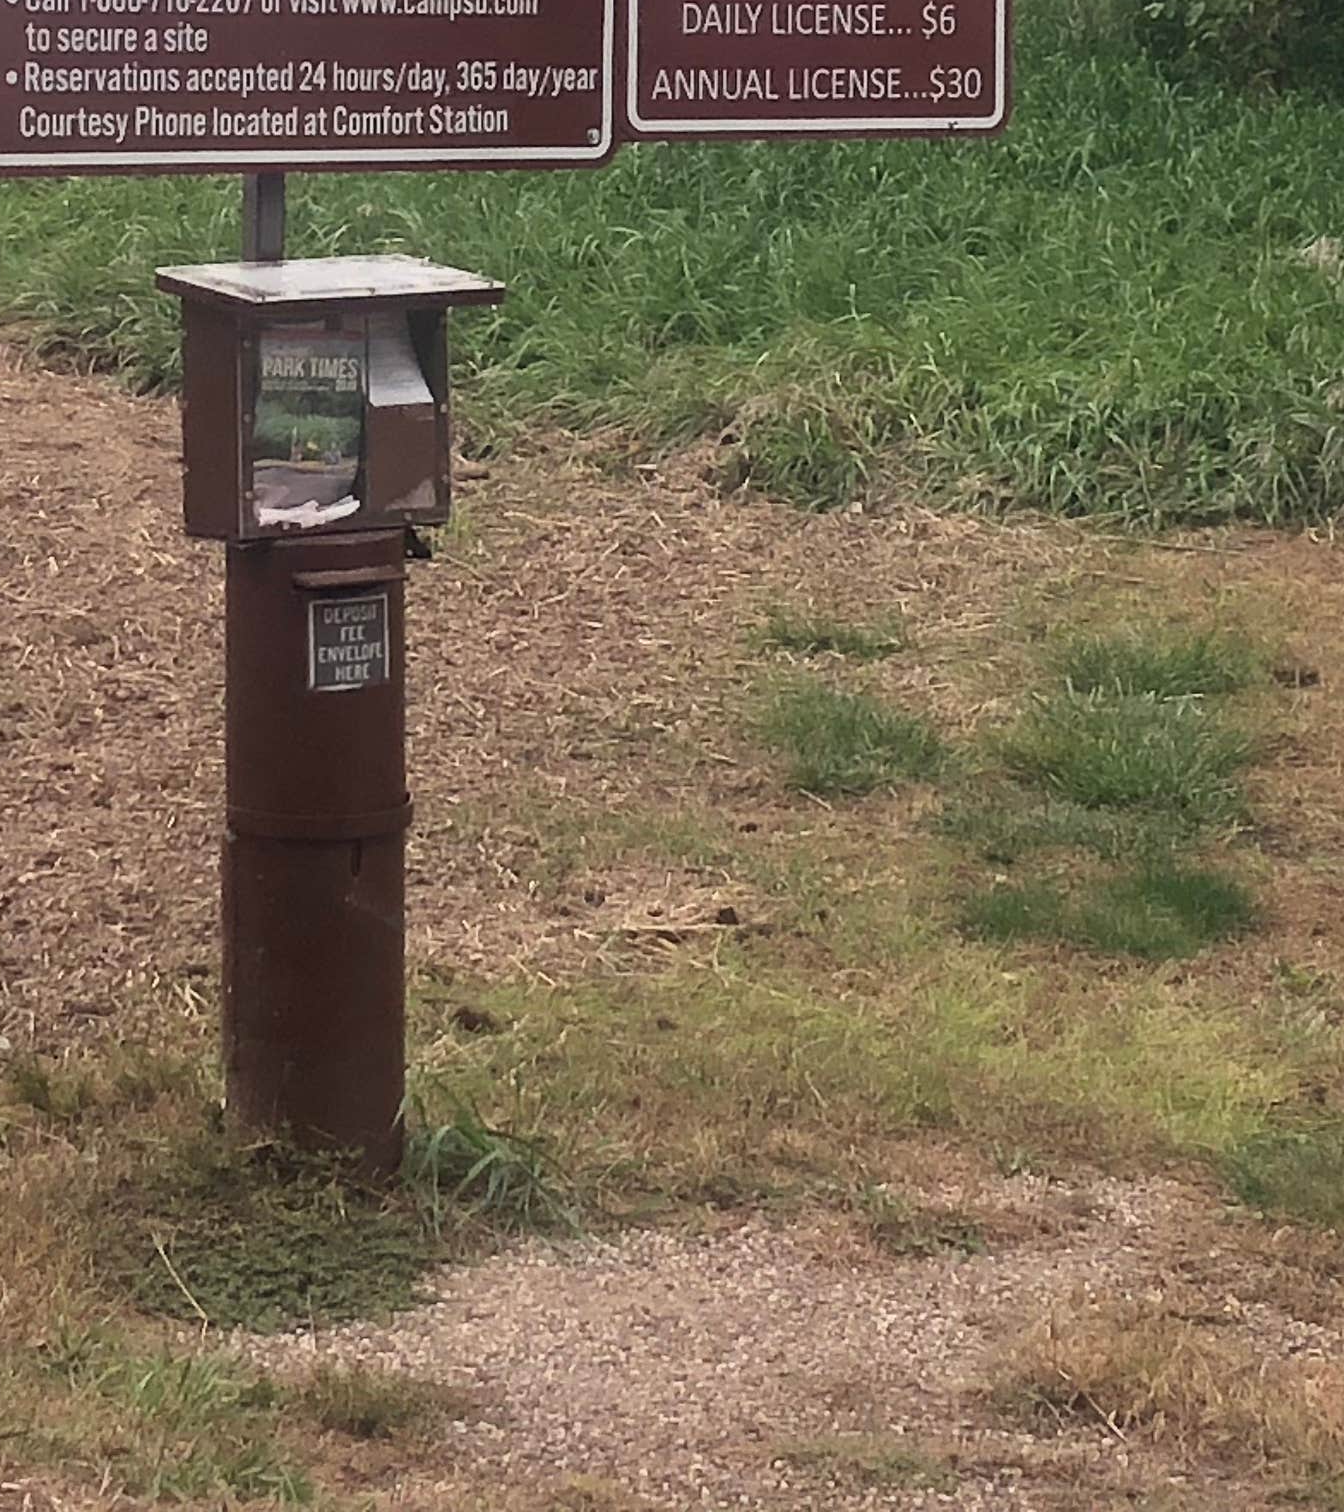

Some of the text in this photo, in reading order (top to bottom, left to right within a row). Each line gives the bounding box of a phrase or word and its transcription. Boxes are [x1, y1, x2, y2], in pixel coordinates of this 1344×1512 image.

[682, 3, 763, 35] DAILY
[921, 0, 955, 40] $6
[25, 22, 208, 53] to secure a site
[24, 61, 598, 98] Reservations accepted 24 hours/day, 365 day/year
[652, 68, 779, 101] ANNUAL
[19, 103, 509, 143] Courtesy Phone located at Comfort Station
[262, 356, 359, 378] PARK TIMES
[324, 604, 377, 624] DEPOSIT
[340, 625, 365, 642] FEE
[318, 642, 383, 663] ENVELOPE
[335, 663, 370, 681] HERE
